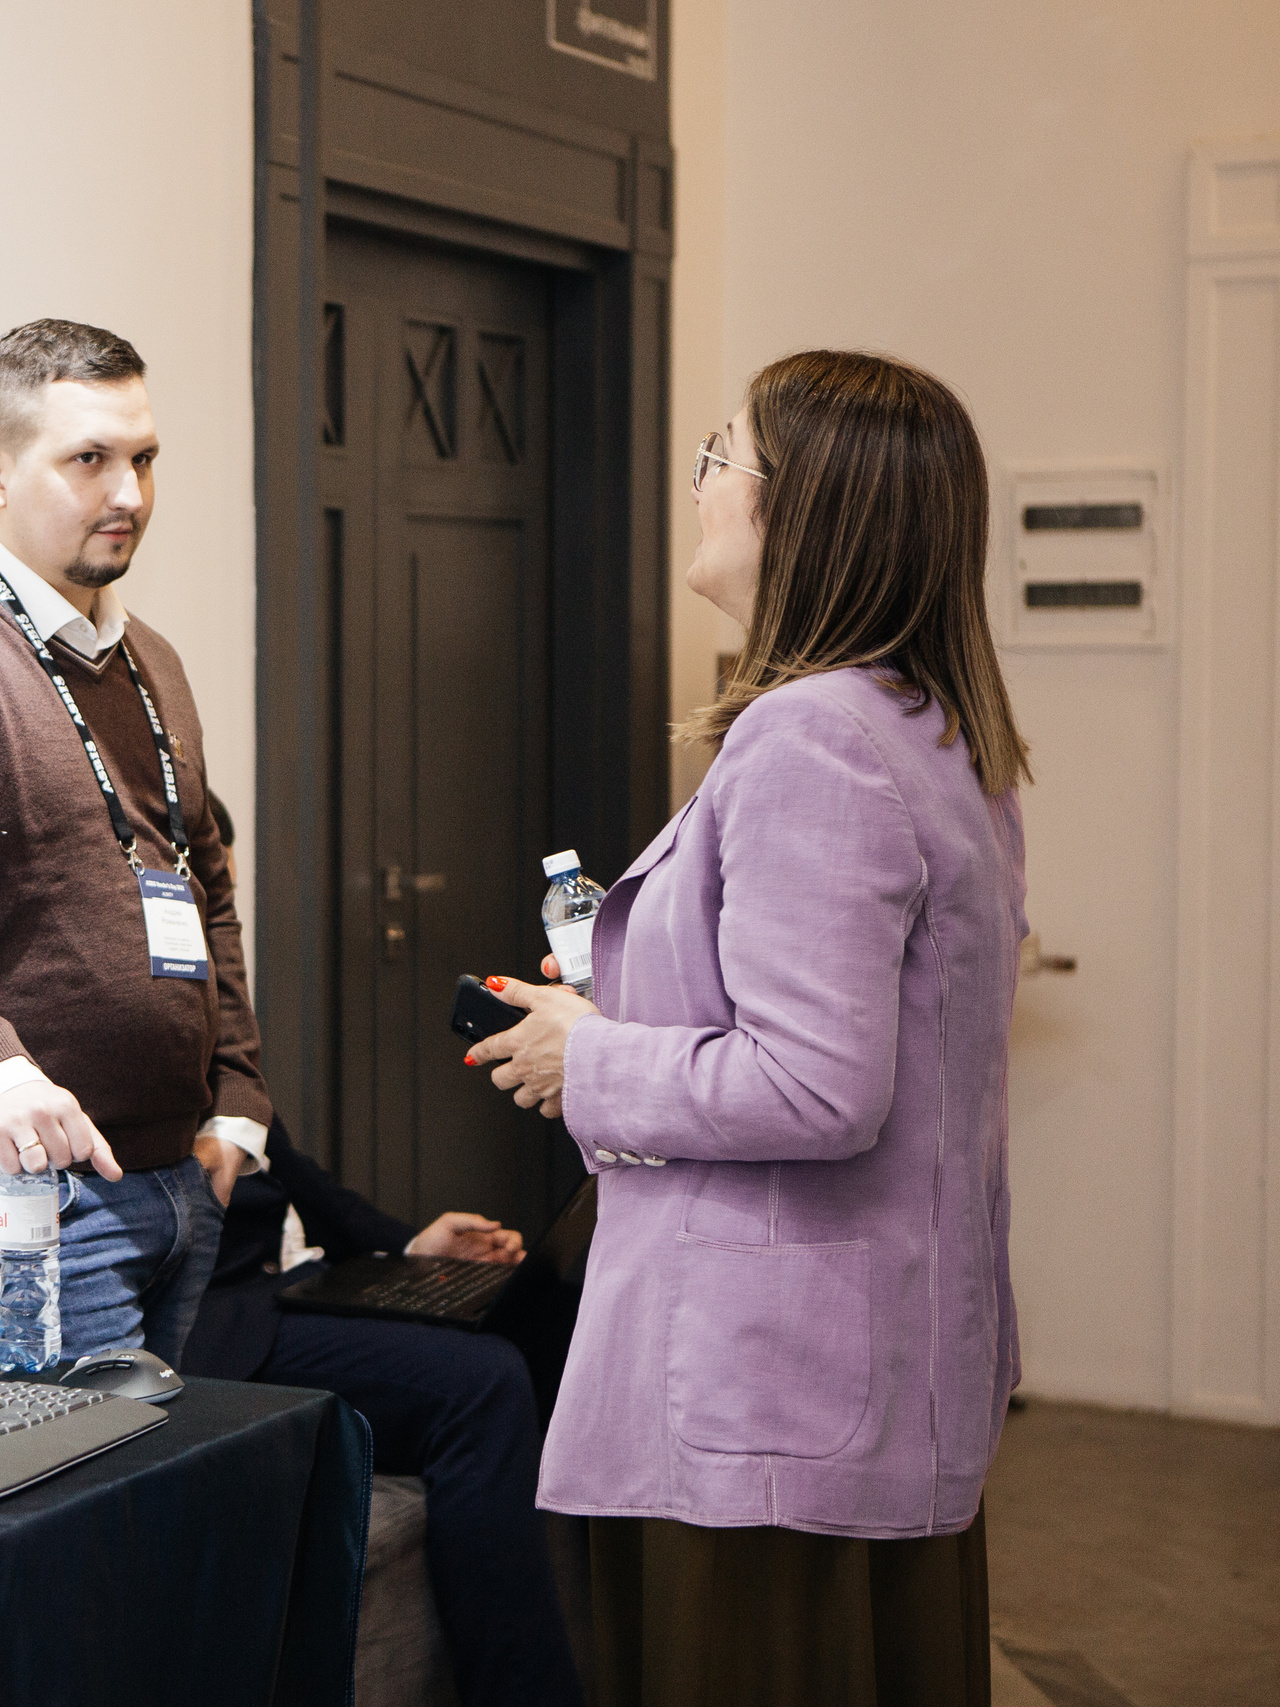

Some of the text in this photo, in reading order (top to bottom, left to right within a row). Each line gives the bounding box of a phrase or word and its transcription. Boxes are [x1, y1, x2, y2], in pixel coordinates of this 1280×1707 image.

[15, 613, 53, 660] ASBIS
[52, 673, 85, 726] ASBIS
[138, 684, 163, 734] ASBIS
[84, 740, 114, 793] ASBIS
[159, 748, 178, 803] ASBIS
